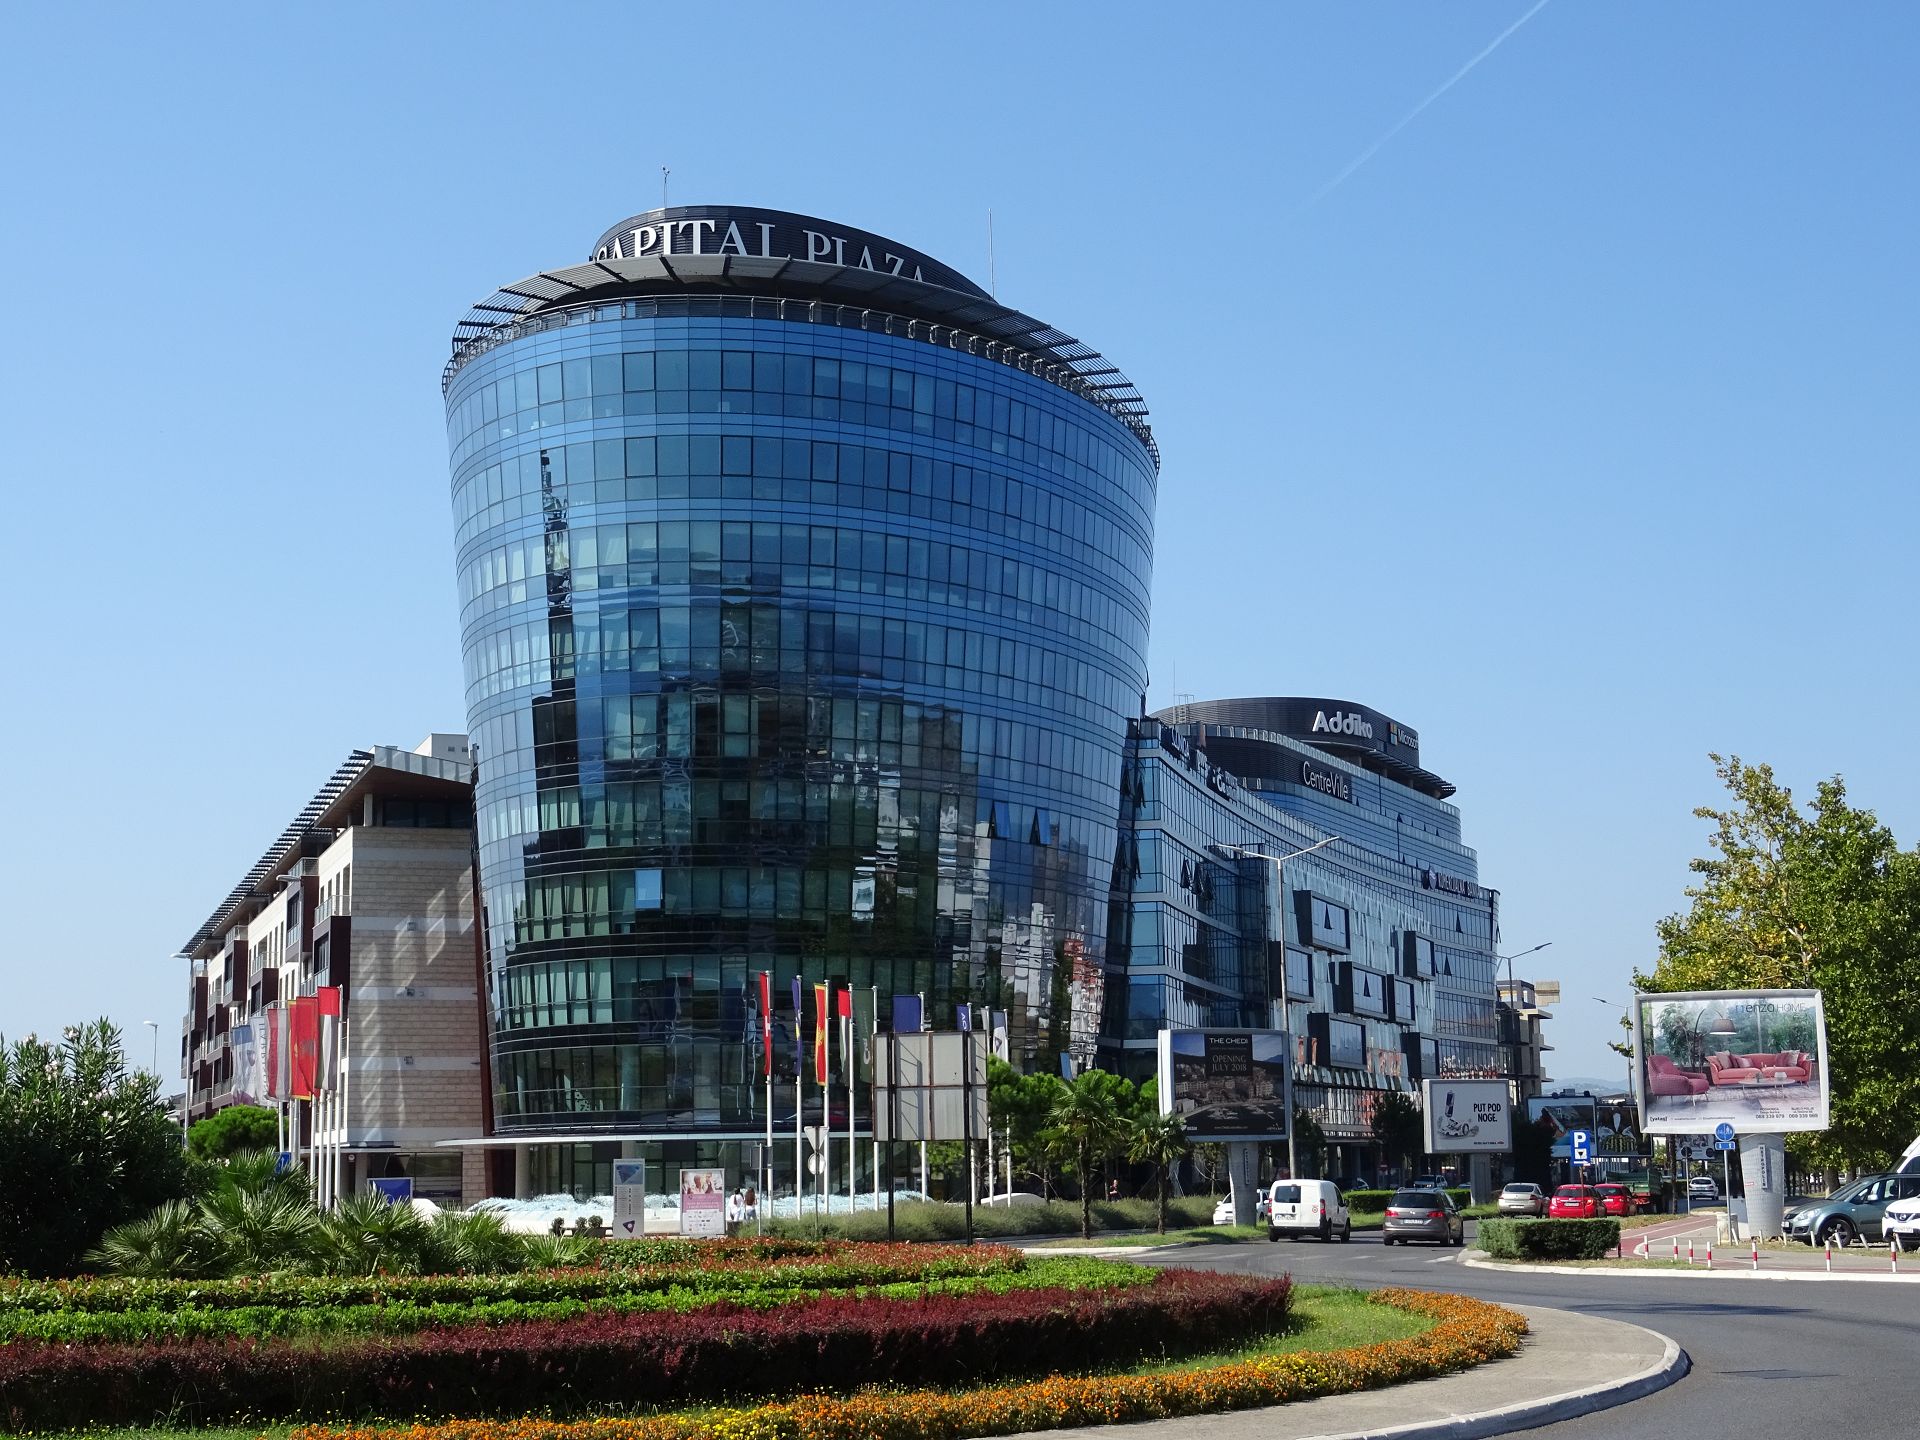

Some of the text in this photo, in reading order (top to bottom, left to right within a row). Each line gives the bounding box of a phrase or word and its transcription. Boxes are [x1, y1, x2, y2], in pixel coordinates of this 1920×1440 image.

[1312, 711, 1373, 740] Addiko
[1303, 761, 1349, 799] CentreVille
[1777, 1003, 1805, 1012] HOME
[1212, 1054, 1246, 1063] OPENING
[1212, 1063, 1247, 1072] JULY 2018
[1473, 1103, 1501, 1112] PUT POD
[1477, 1113, 1497, 1122] NOGE.
[1574, 1132, 1587, 1147] P
